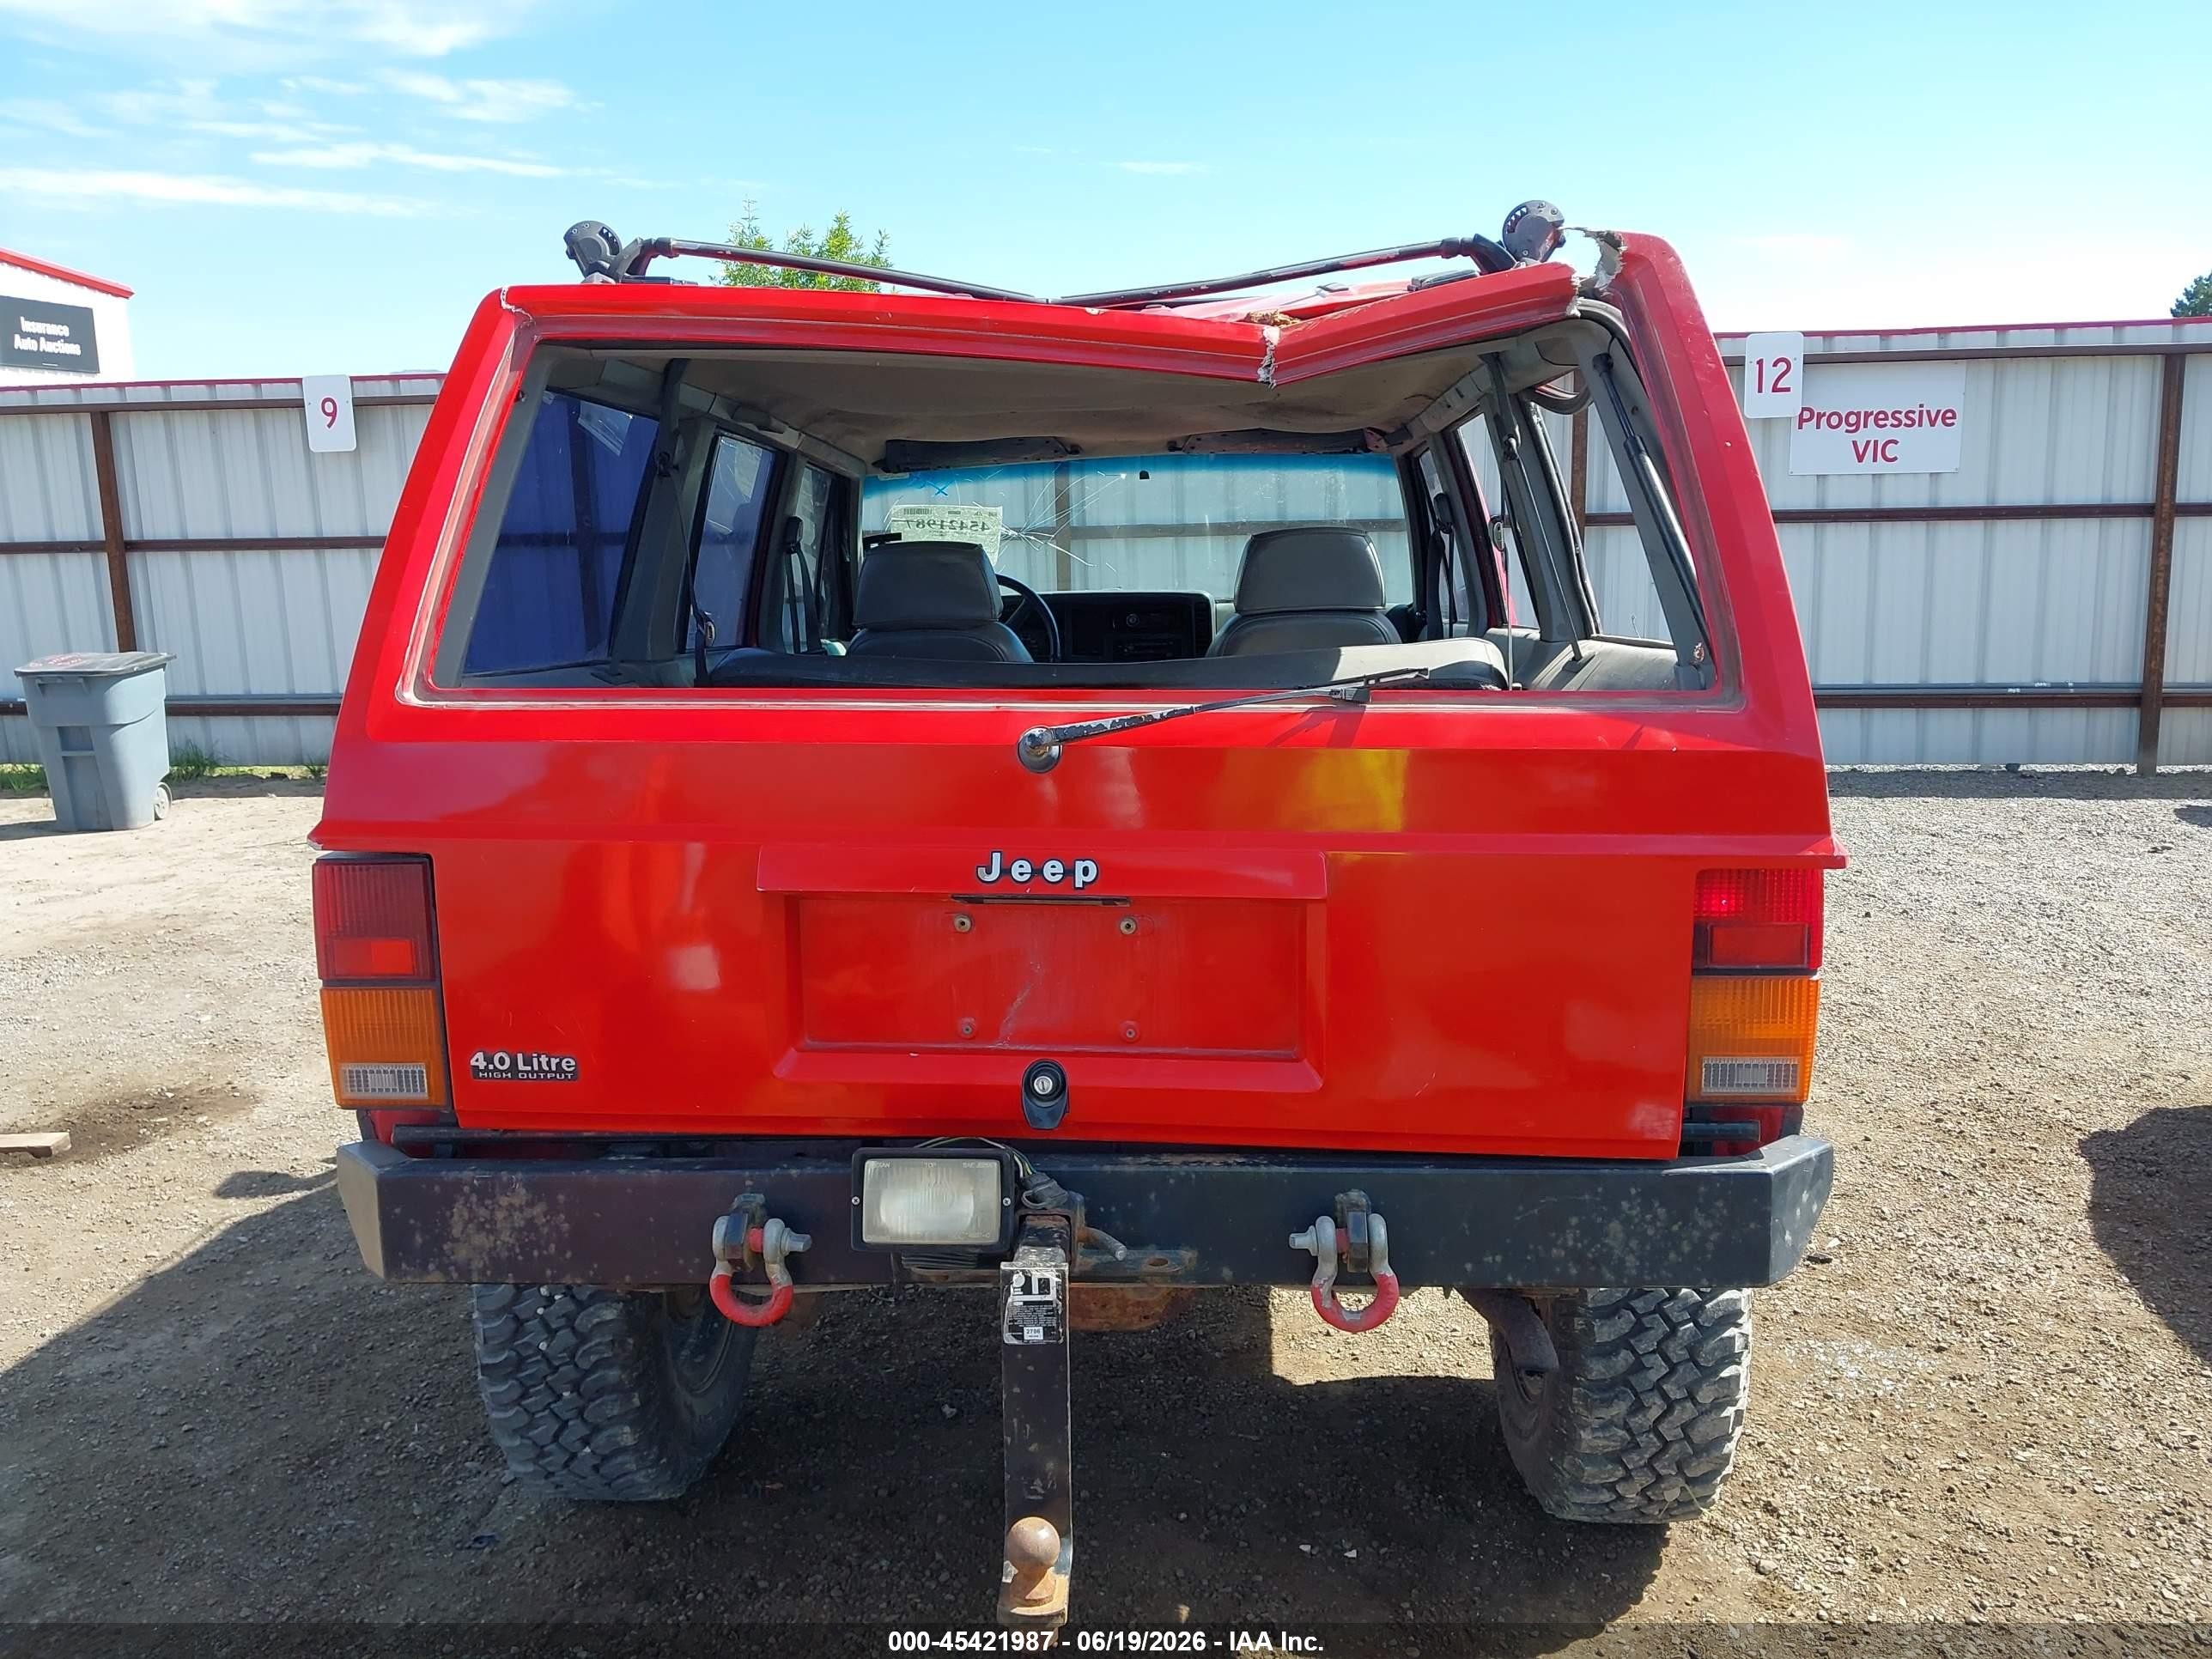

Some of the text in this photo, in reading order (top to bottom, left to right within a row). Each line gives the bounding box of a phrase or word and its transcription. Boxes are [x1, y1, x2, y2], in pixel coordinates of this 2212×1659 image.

[20, 316, 70, 337] Insurance
[14, 333, 82, 356] Auto Auctions
[1756, 356, 1792, 394] 12
[320, 398, 337, 429] 9
[1797, 403, 1957, 434] Progressive
[1851, 438, 1899, 463] VIC
[976, 851, 1099, 889] Jeep
[470, 1051, 576, 1072] 4.0 Litre
